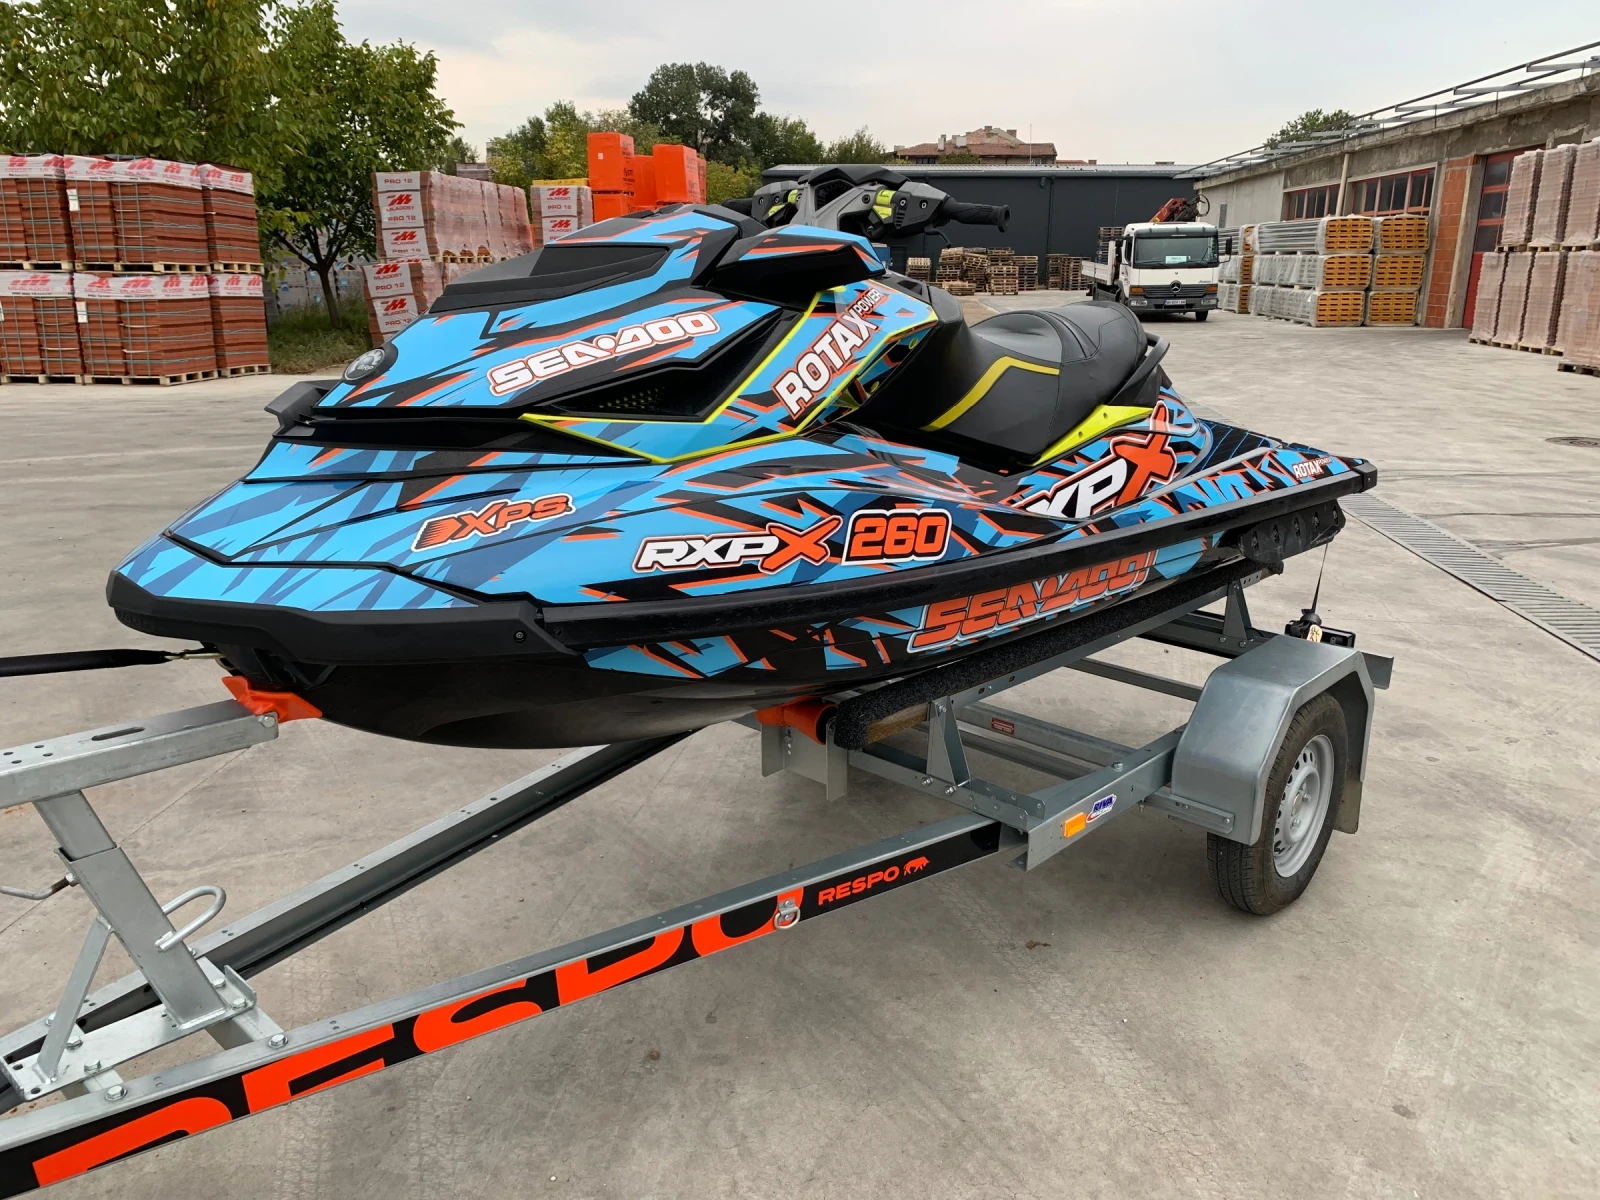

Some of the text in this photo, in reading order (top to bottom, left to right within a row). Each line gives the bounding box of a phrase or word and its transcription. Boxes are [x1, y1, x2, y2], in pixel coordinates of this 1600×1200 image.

[373, 272, 403, 280] MLADOST
[773, 287, 883, 417] ROTAX POWER
[1292, 460, 1324, 479] ROTAX
[450, 494, 571, 539] XPS
[849, 515, 949, 559] 260
[1093, 795, 1114, 813] RIVA
[817, 866, 900, 906] RESPO
